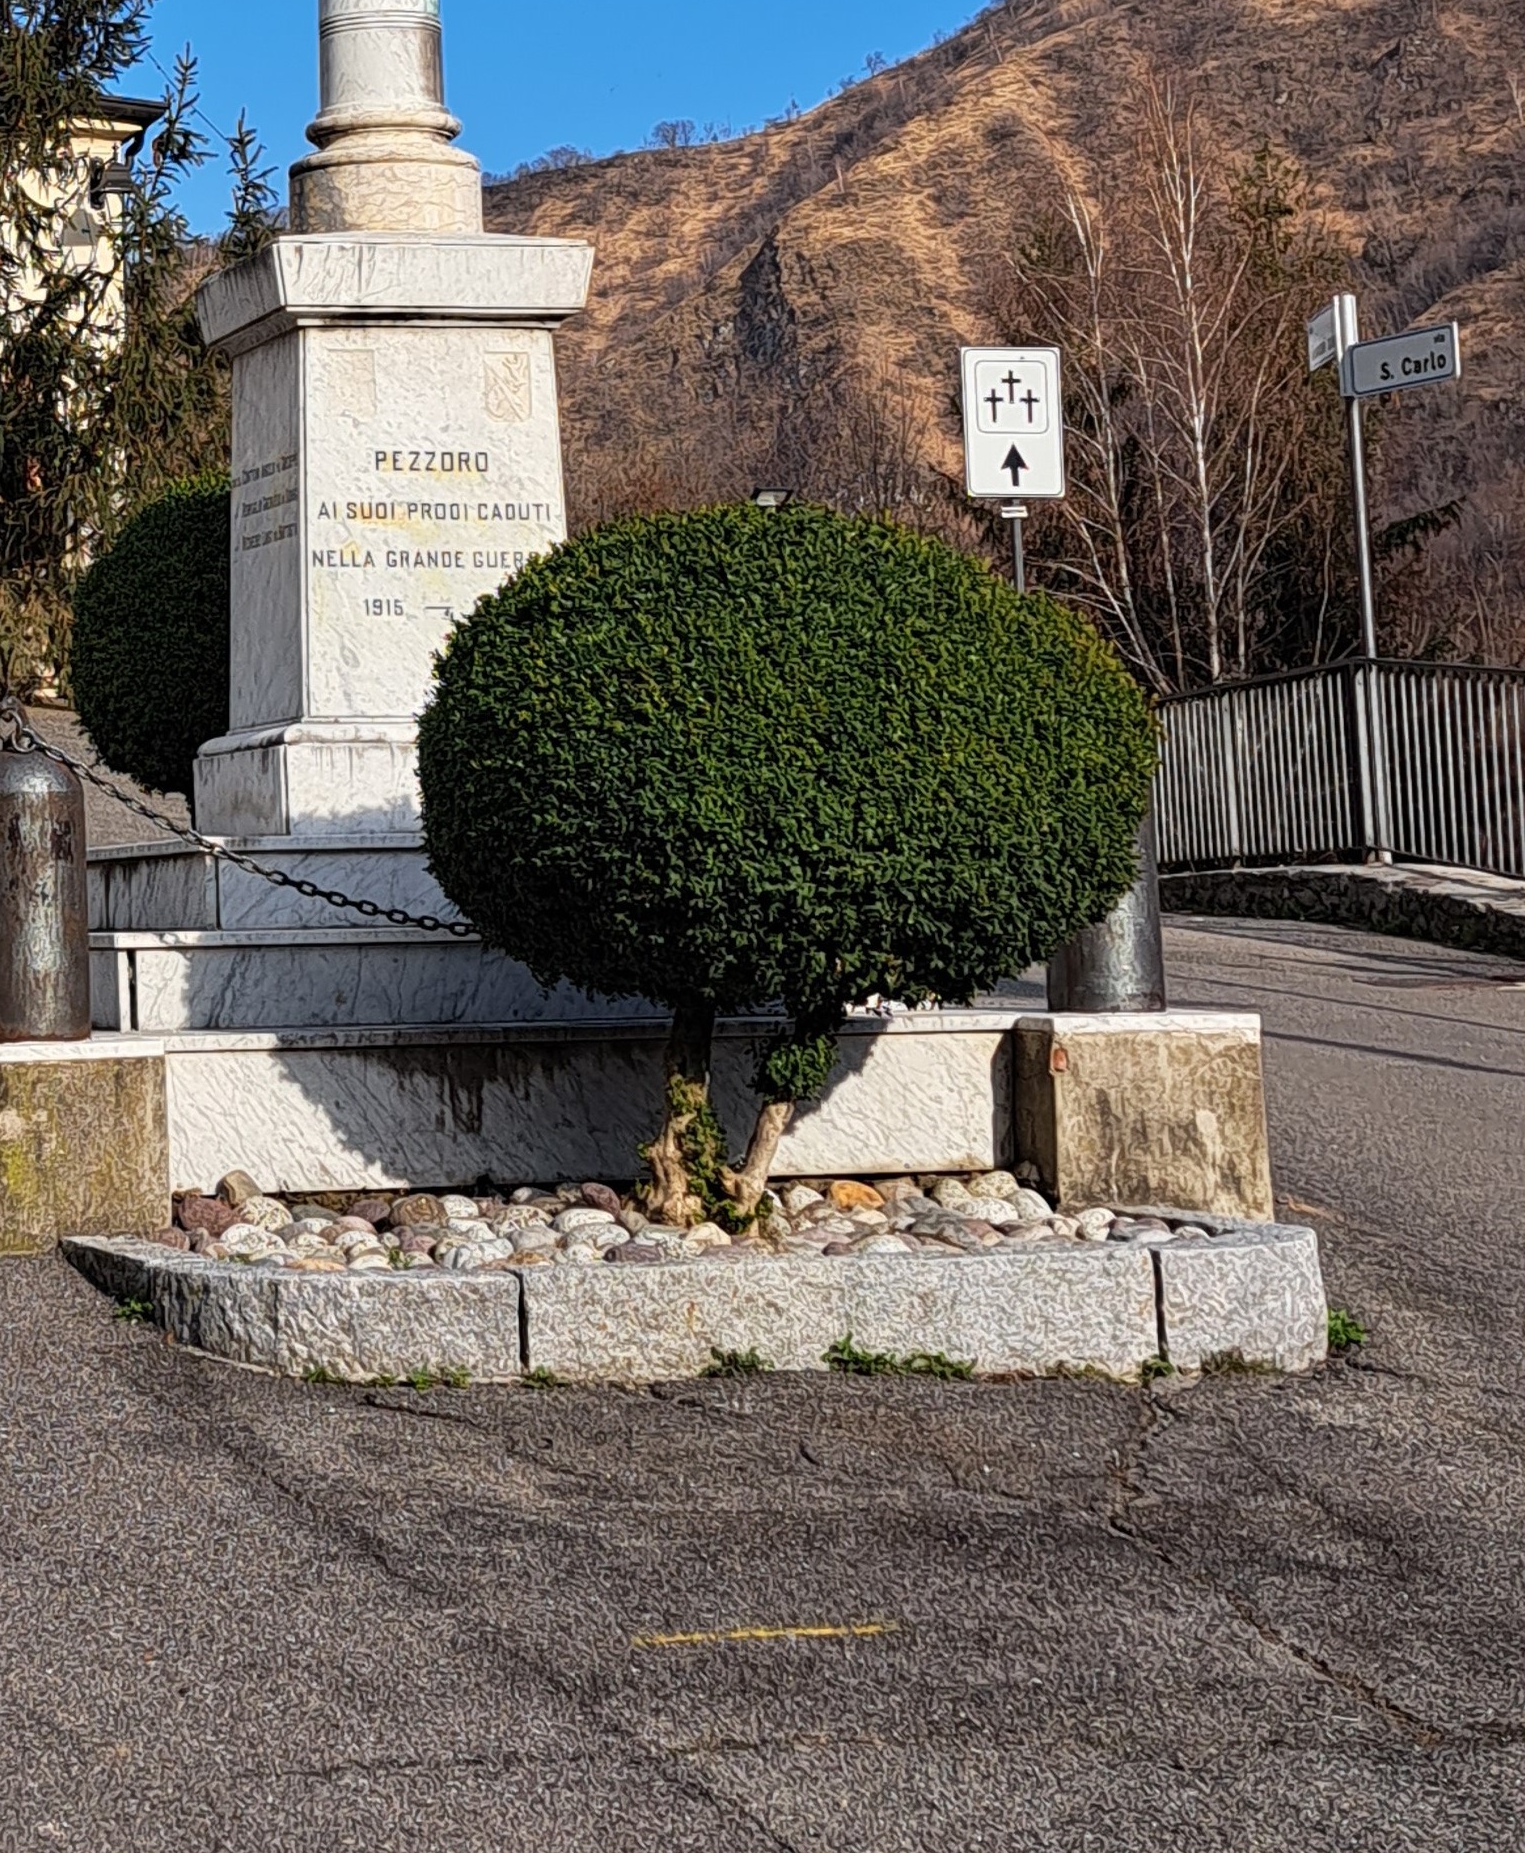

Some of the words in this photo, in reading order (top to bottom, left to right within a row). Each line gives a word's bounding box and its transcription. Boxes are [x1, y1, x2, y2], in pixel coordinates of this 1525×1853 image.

[1380, 362, 1394, 380] S.
[1402, 351, 1446, 376] Carlo
[375, 451, 489, 473] PEZZORO
[318, 502, 337, 520] AI
[346, 502, 396, 520] SUOI
[477, 503, 551, 522] CADUTI
[312, 550, 376, 568] NELLA
[386, 550, 465, 569] GRANDE
[364, 599, 404, 616] 1915
